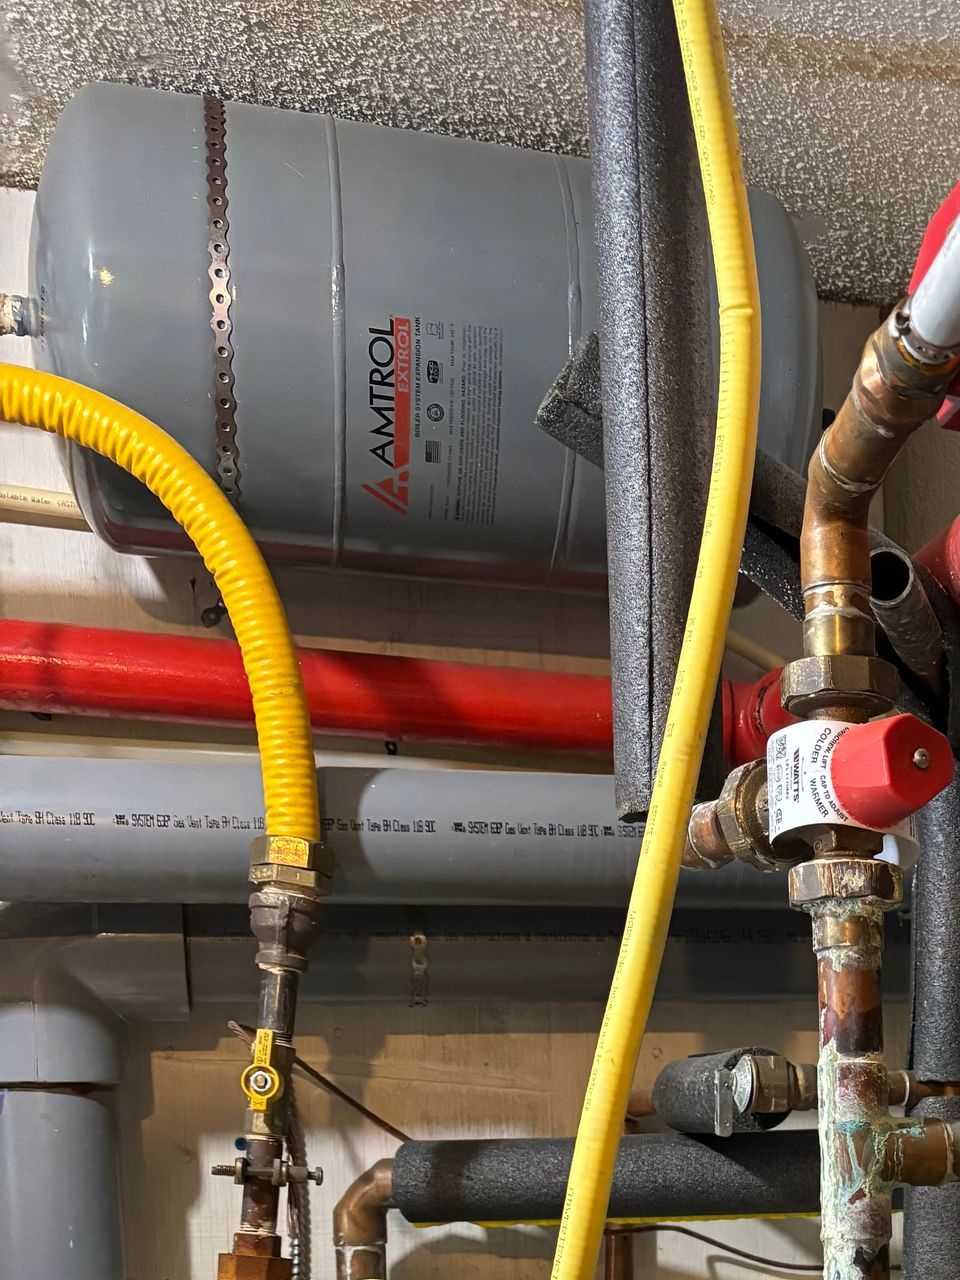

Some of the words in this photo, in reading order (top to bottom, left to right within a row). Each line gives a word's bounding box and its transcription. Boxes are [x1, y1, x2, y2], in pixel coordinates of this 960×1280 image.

[397, 322, 409, 392] EXTROL
[369, 318, 394, 467] AMTROL
[810, 727, 832, 764] COLDER
[820, 754, 829, 769] LIFT
[820, 774, 828, 789] CAP
[824, 790, 831, 800] TO
[809, 778, 829, 818] WARMER
[829, 800, 849, 822] ADJUST
